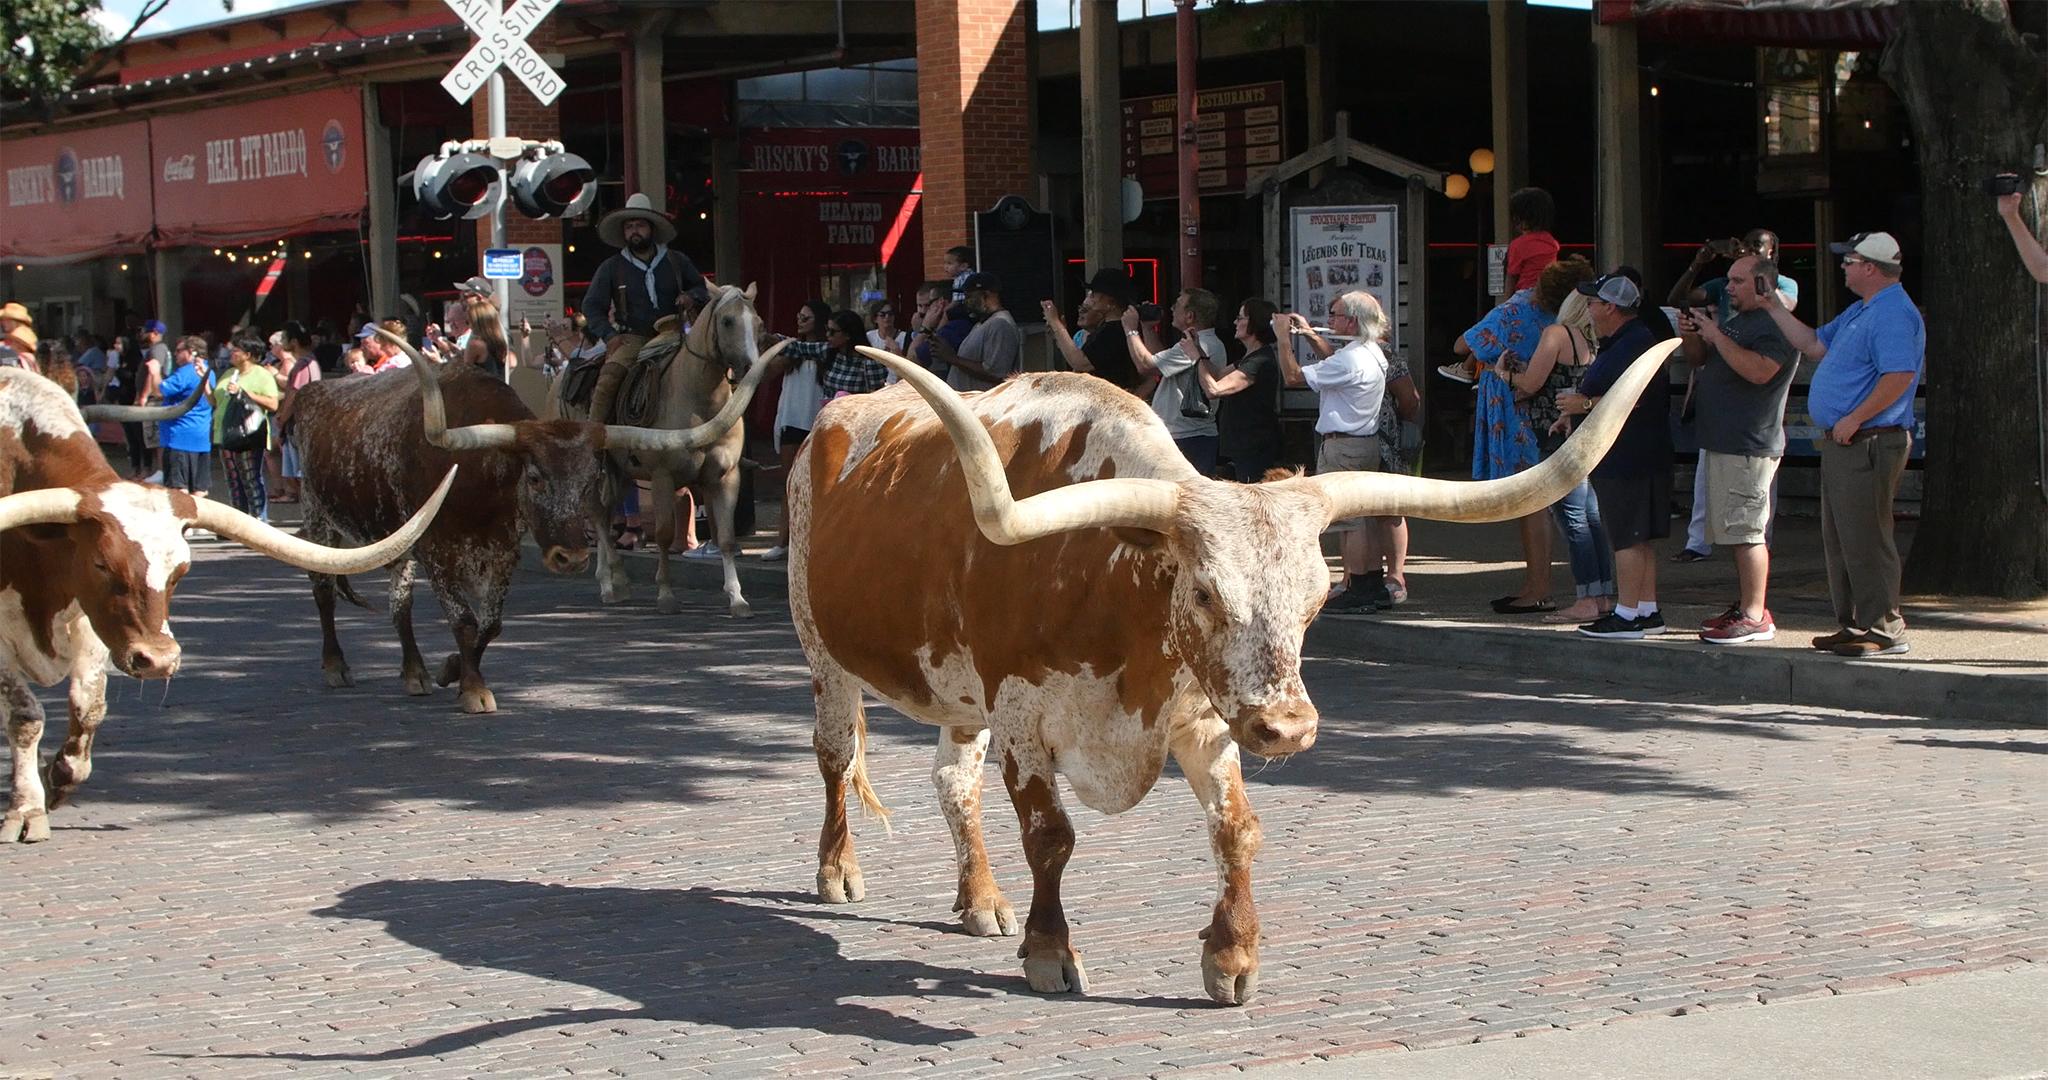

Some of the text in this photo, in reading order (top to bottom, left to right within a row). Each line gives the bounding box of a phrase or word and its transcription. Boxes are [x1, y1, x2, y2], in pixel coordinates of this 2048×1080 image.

[454, 0, 551, 91] CROSSIN
[509, 46, 557, 96] ROAD
[1152, 87, 1265, 113] SHOP ESTAURANTS
[1123, 105, 1137, 180] WELCOM
[206, 139, 239, 184] REAL
[240, 134, 261, 180] PIT
[753, 145, 829, 173] RISCKY'S
[819, 202, 882, 222] HEATED
[828, 225, 875, 244] PATIO
[1357, 242, 1387, 263] TEXAS
